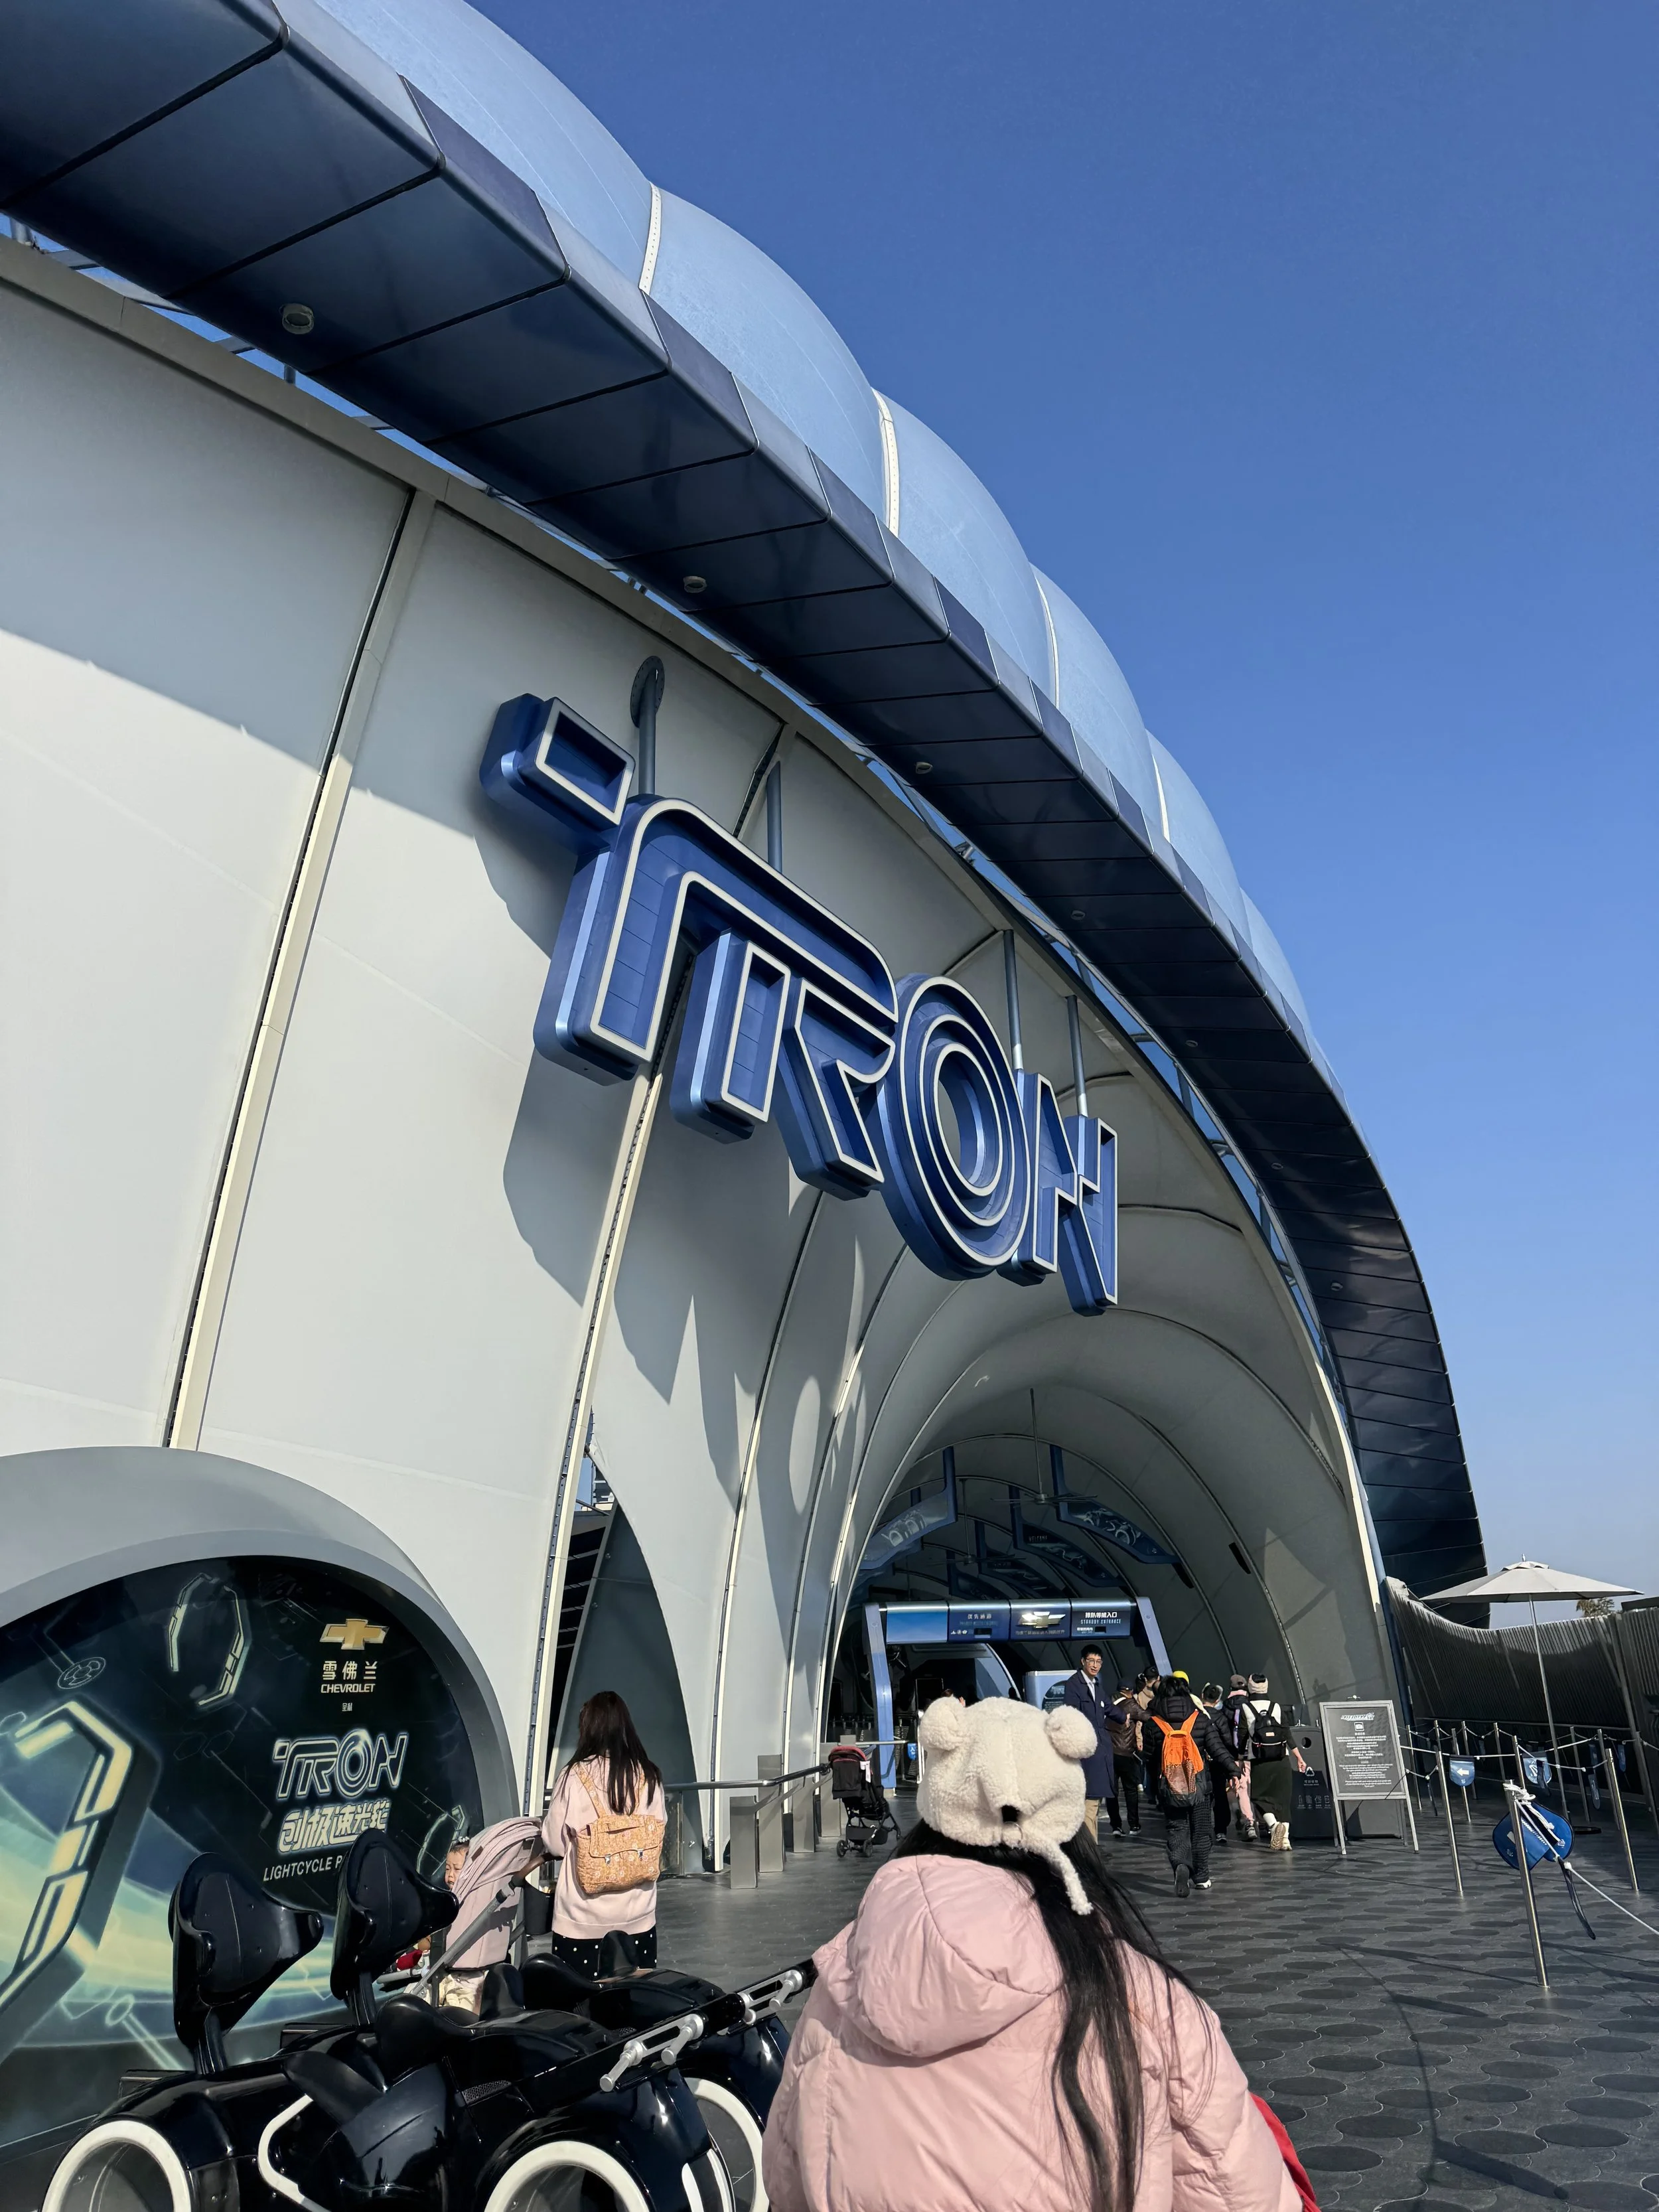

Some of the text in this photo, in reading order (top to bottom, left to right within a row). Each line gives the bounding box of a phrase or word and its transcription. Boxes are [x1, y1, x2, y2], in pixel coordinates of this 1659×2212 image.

[480, 693, 1118, 1314] TRON
[322, 1660, 378, 1680] 雪佛兰
[321, 1683, 376, 1694] CHEVROLET
[273, 1731, 407, 1799] TRON
[263, 1856, 333, 1881] LIGHTCYCLE
